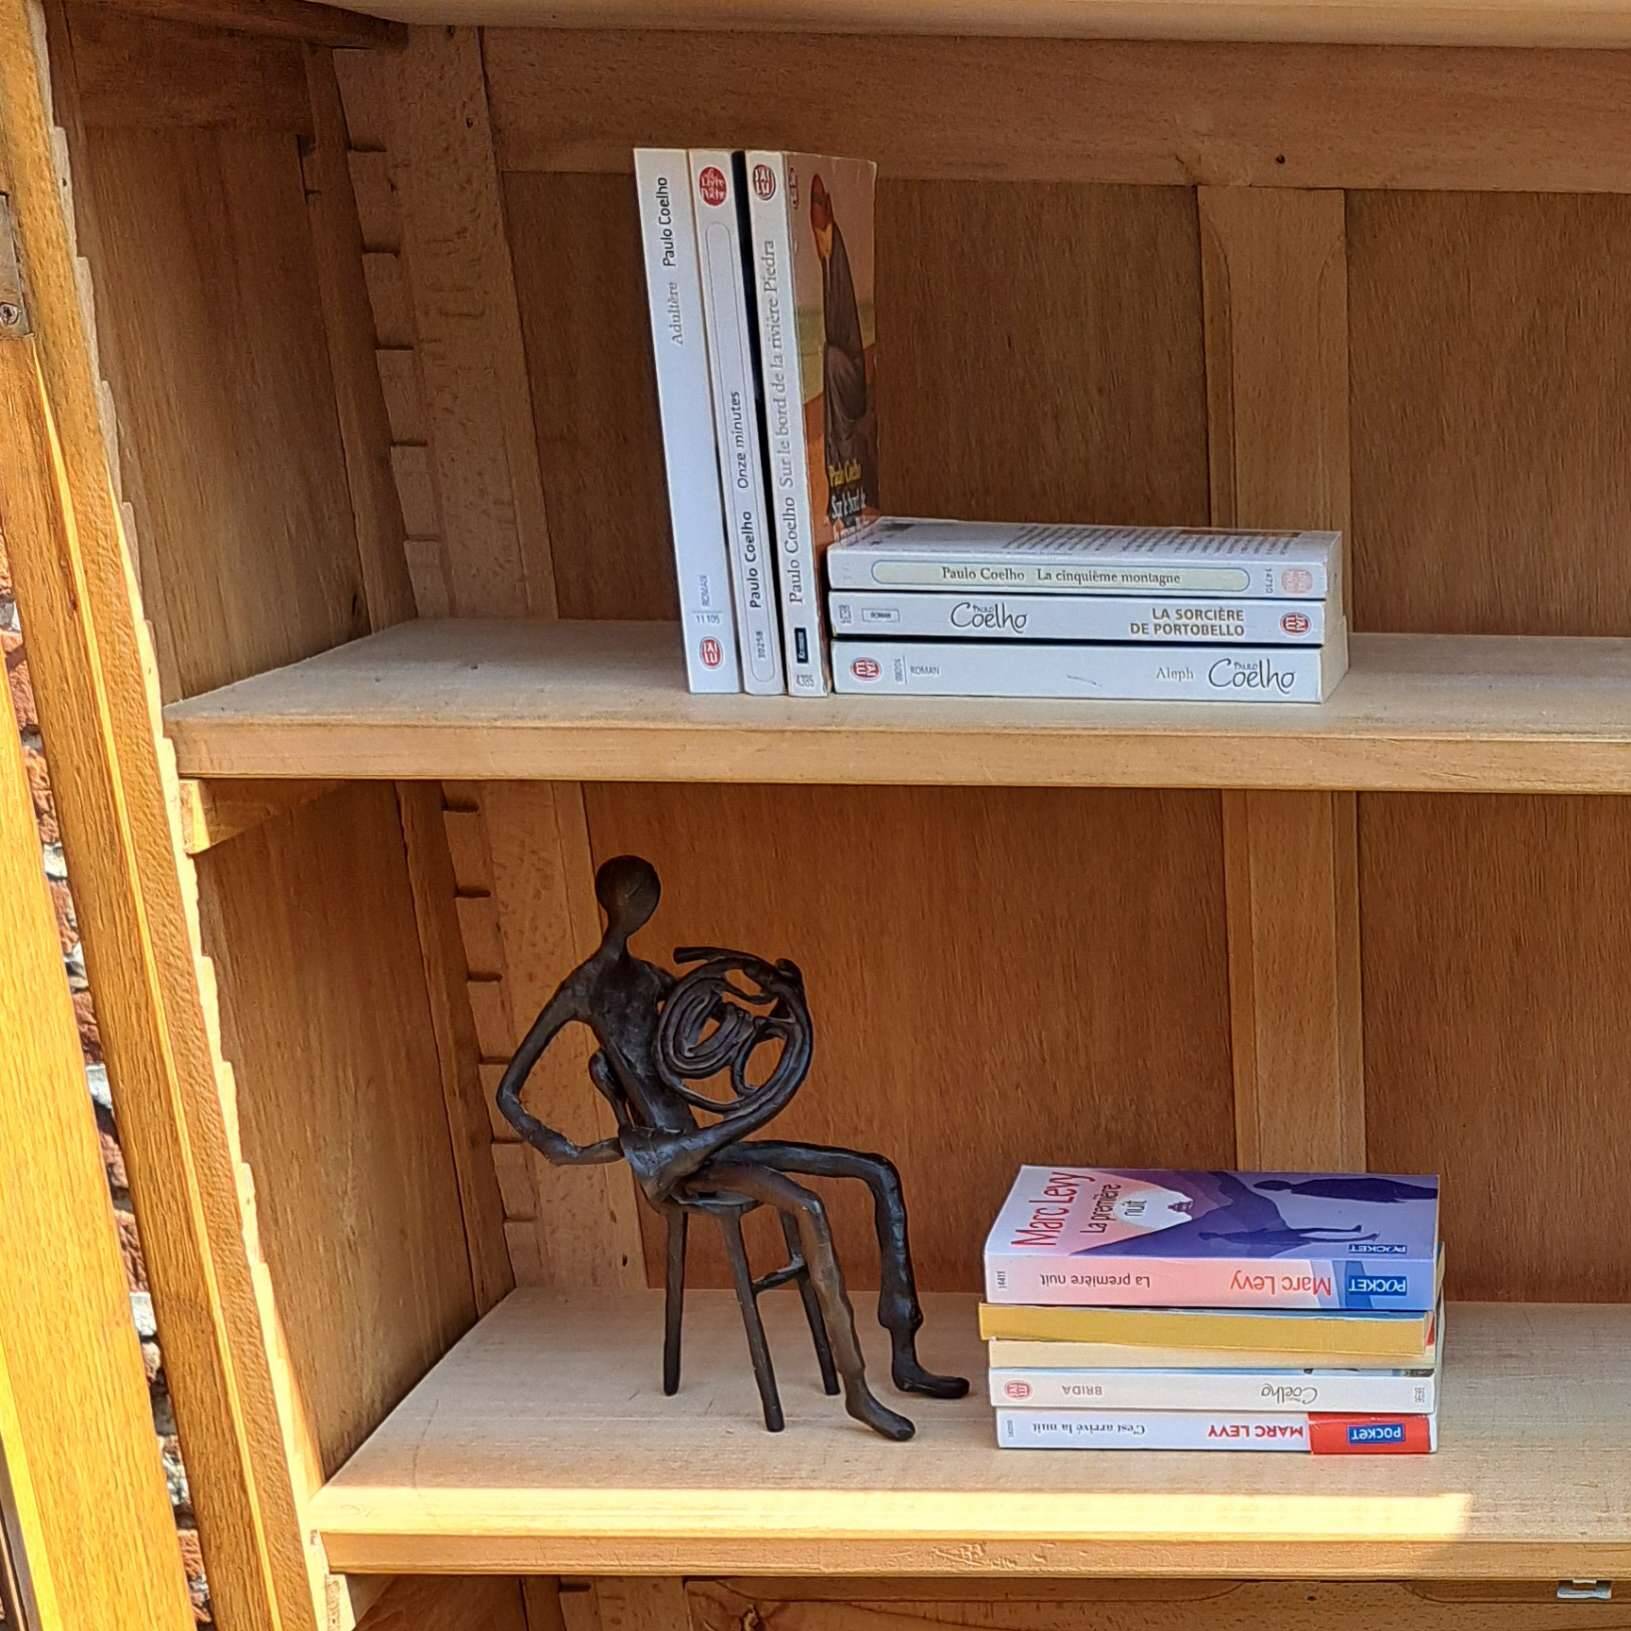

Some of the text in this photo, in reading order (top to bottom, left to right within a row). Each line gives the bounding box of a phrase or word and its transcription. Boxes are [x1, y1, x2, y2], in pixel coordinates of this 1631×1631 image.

[656, 177, 676, 267] Paulo Coelho
[668, 282, 683, 345] Adultère
[731, 391, 762, 608] Paulo Coelho Onze minutes
[942, 566, 1181, 587] Paulo Coelho La cinquième montagne
[950, 602, 1027, 633] Coelho
[1152, 606, 1244, 622] LA SORCIÈRE
[1130, 623, 1245, 637] DE PORTOBELLO
[1156, 666, 1195, 682] Aleph
[1011, 1171, 1096, 1246] Marc Levy
[1040, 1273, 1150, 1288] La première nuit
[1230, 1270, 1332, 1296] Marc Levy
[1348, 1277, 1407, 1294] POCKET
[1061, 1385, 1103, 1396] BRIDA
[1260, 1383, 1318, 1405] Coelho
[1032, 1422, 1145, 1435] C'est arrivé la nuit
[1207, 1424, 1304, 1438] MARC LEVY
